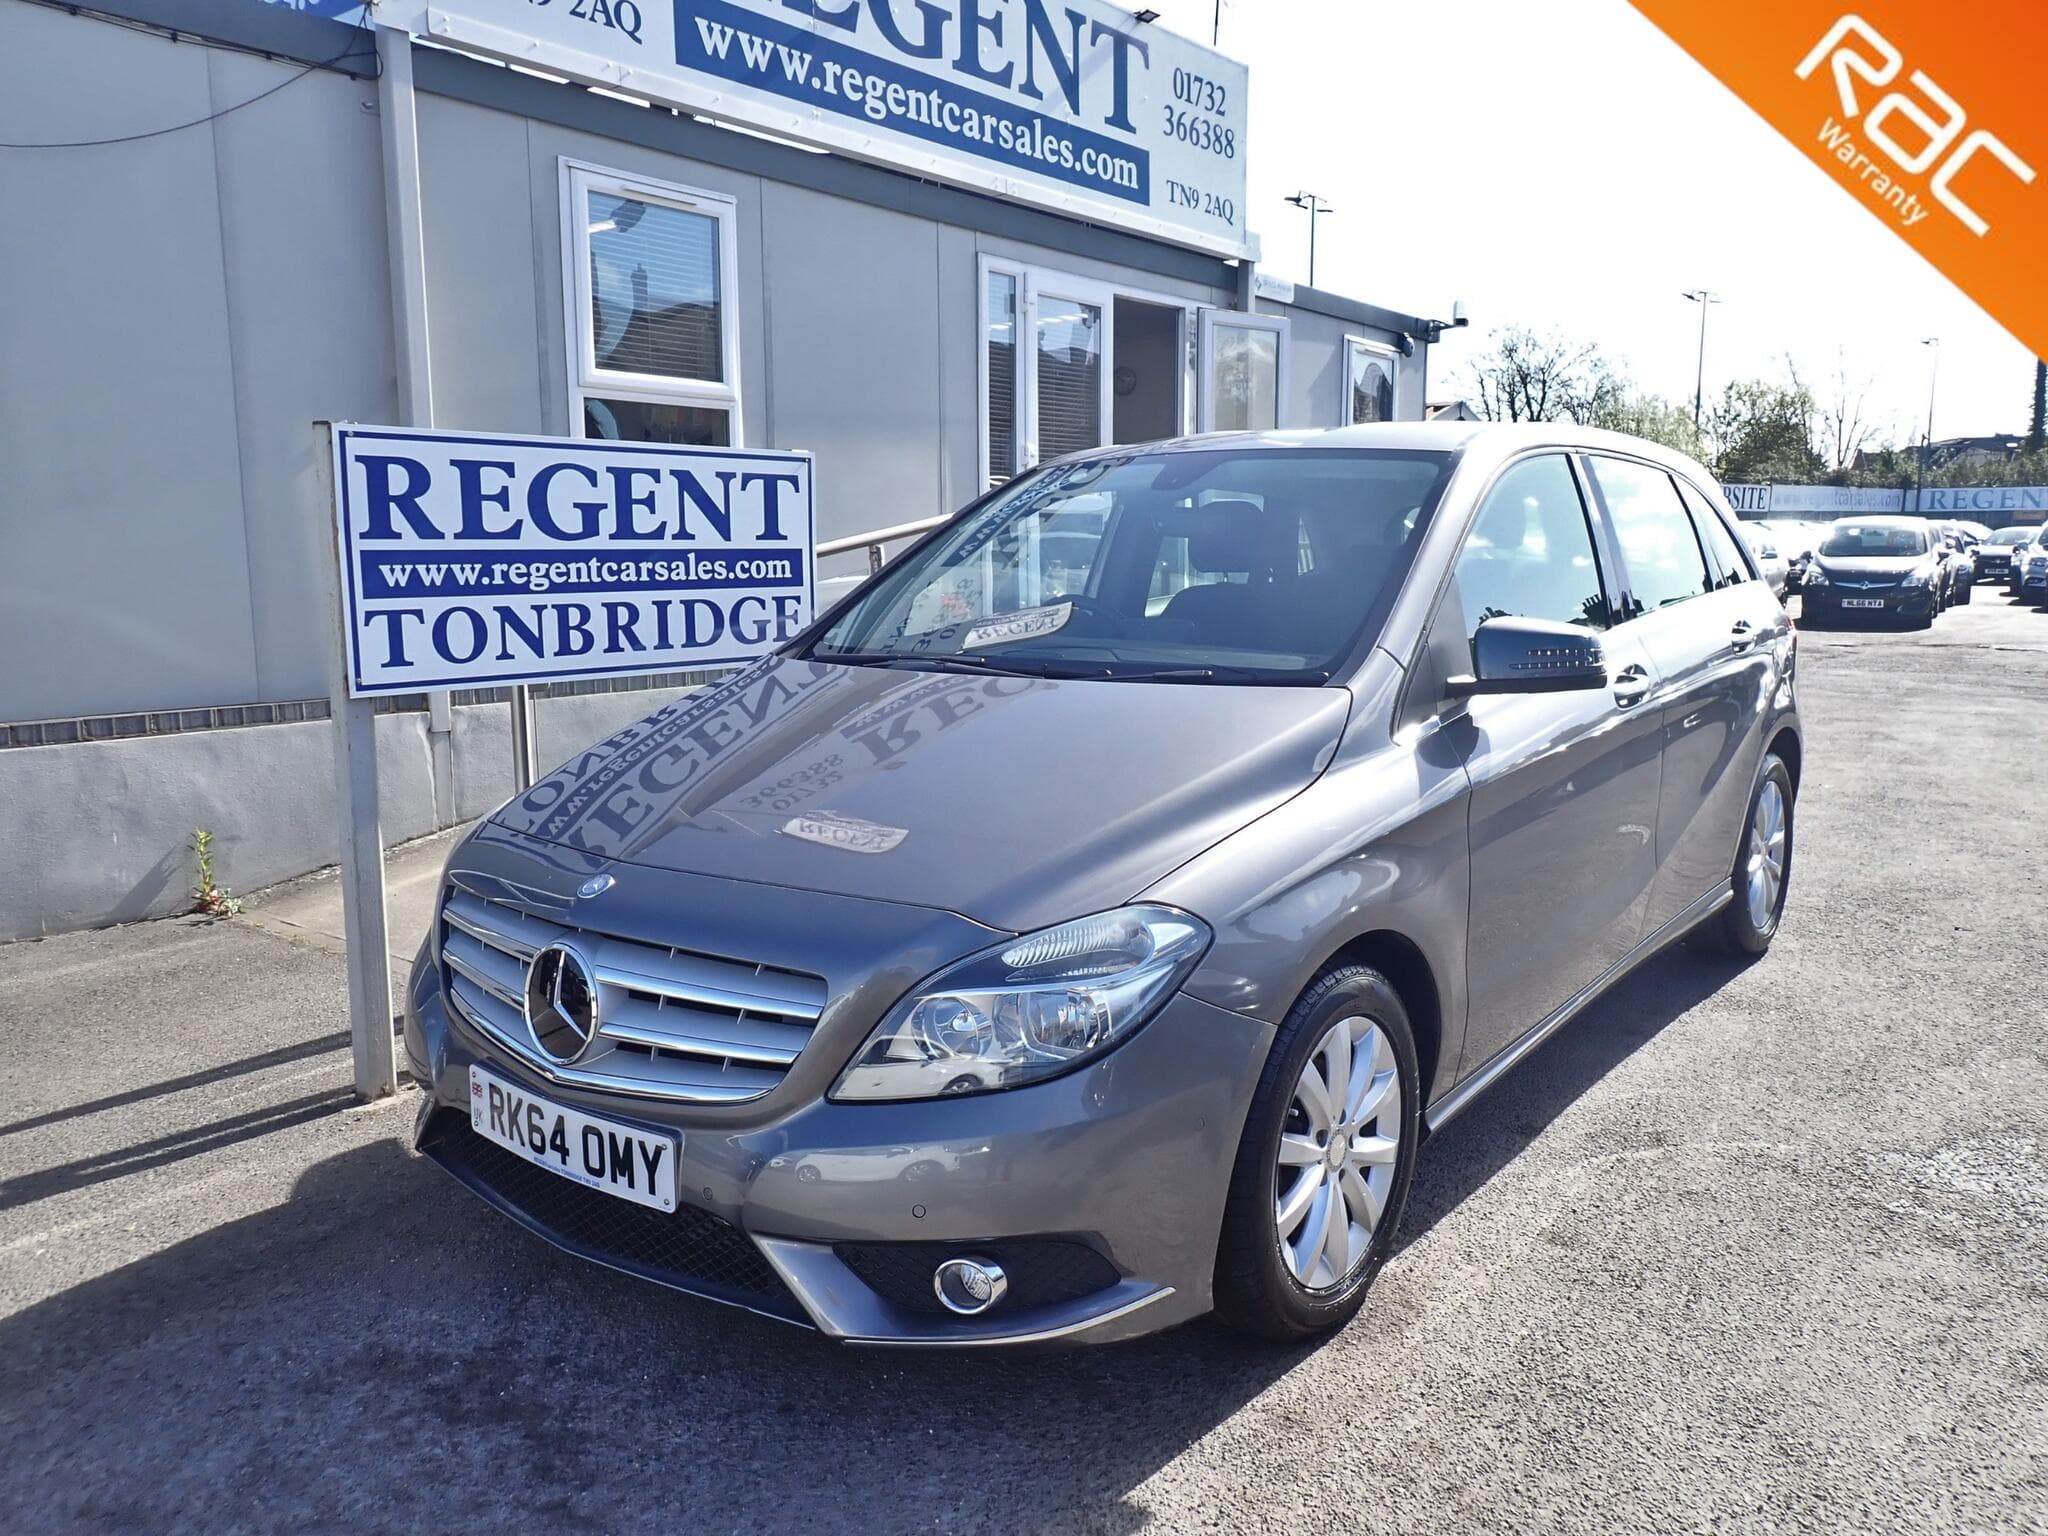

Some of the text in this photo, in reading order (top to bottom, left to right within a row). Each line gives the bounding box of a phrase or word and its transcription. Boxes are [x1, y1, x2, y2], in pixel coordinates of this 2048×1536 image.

[695, 16, 1139, 190] www.regentcarsales.com
[768, 0, 1149, 134] GENT
[1173, 67, 1227, 117] 01732
[1163, 104, 1235, 159] 366388
[1166, 179, 1234, 227] TN9 2AQ
[355, 454, 800, 542] REGENT
[379, 553, 792, 591] www.regentcarsales.com
[364, 595, 802, 669] TONBRIDGE
[489, 1082, 570, 1166] RK64
[582, 1125, 663, 1197] OMY
